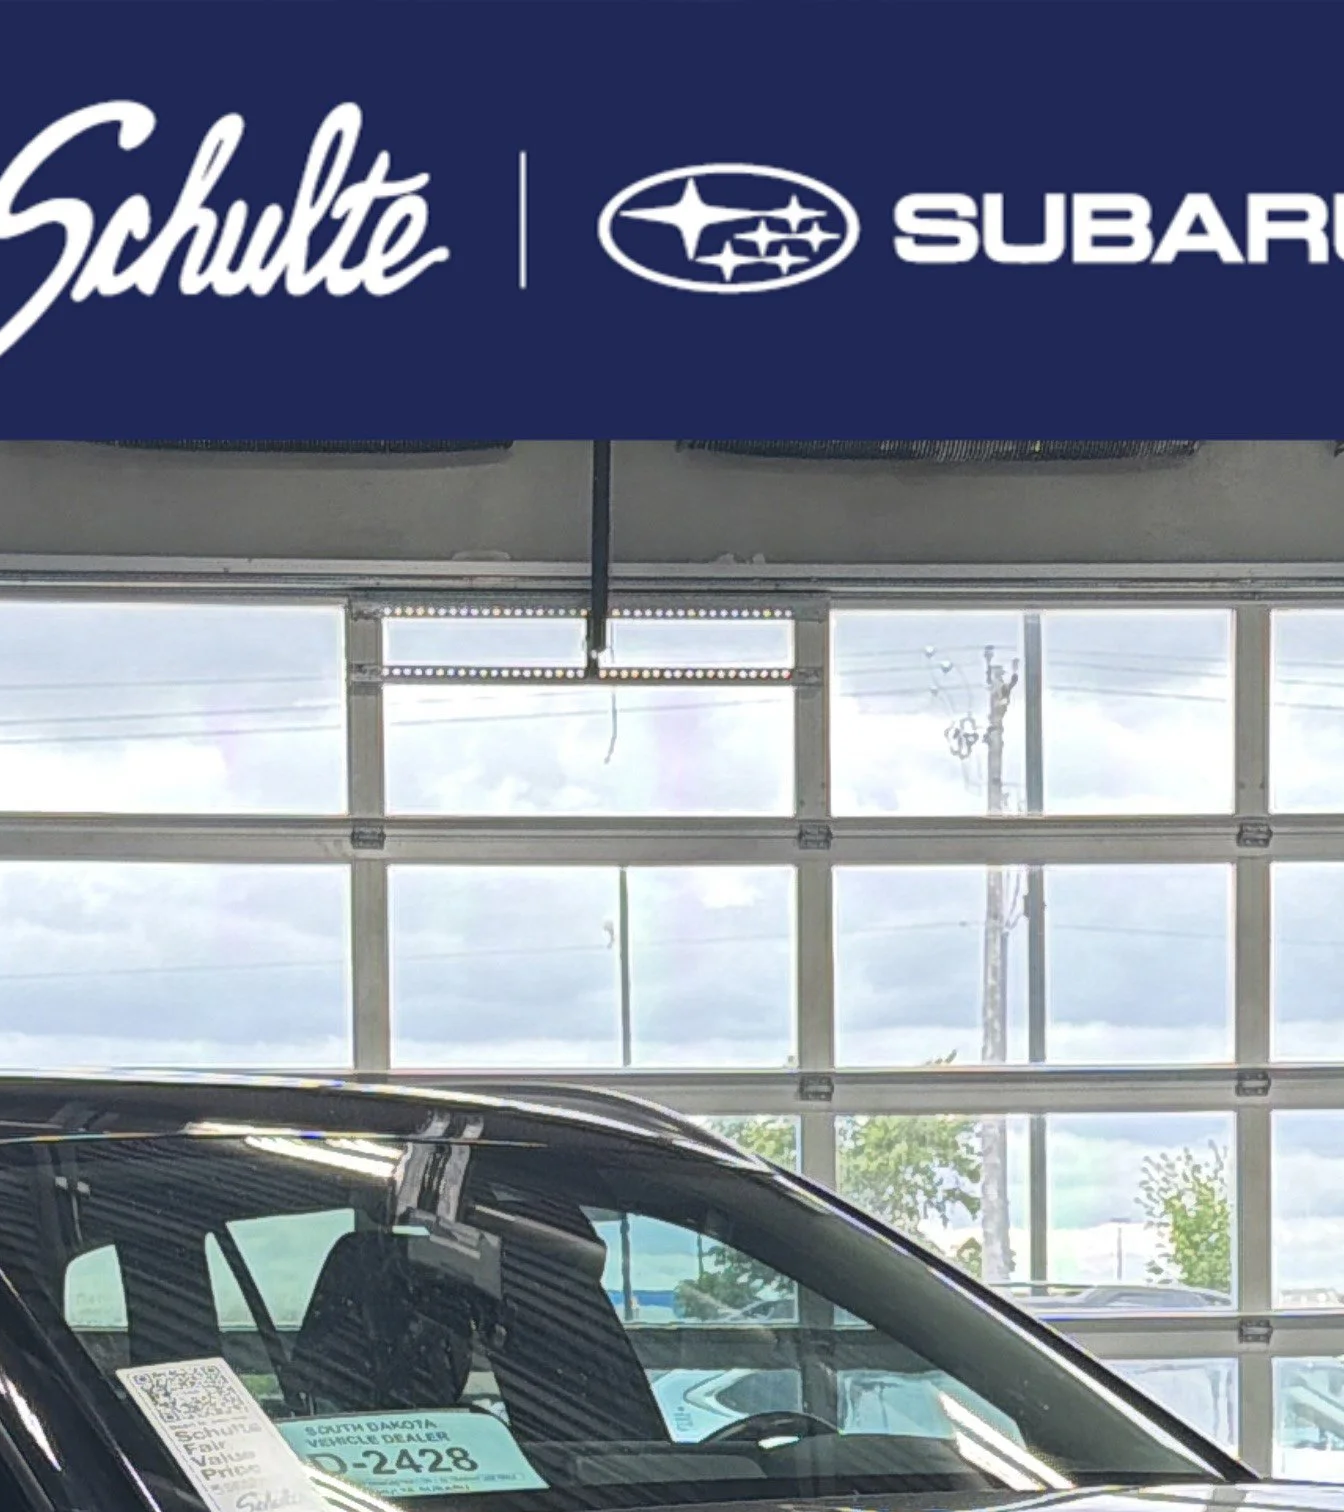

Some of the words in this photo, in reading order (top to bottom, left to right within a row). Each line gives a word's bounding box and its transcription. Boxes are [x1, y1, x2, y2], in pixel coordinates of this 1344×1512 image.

[175, 1422, 262, 1441] Schulte
[305, 1422, 364, 1436] SOUTH
[366, 1418, 438, 1432] DAKOTA
[183, 1439, 226, 1456] Fair
[306, 1434, 379, 1448] VEHICLE
[381, 1430, 450, 1444] DEALER
[191, 1450, 257, 1467] Value
[306, 1446, 479, 1476] D-2428
[200, 1463, 261, 1481] Price
